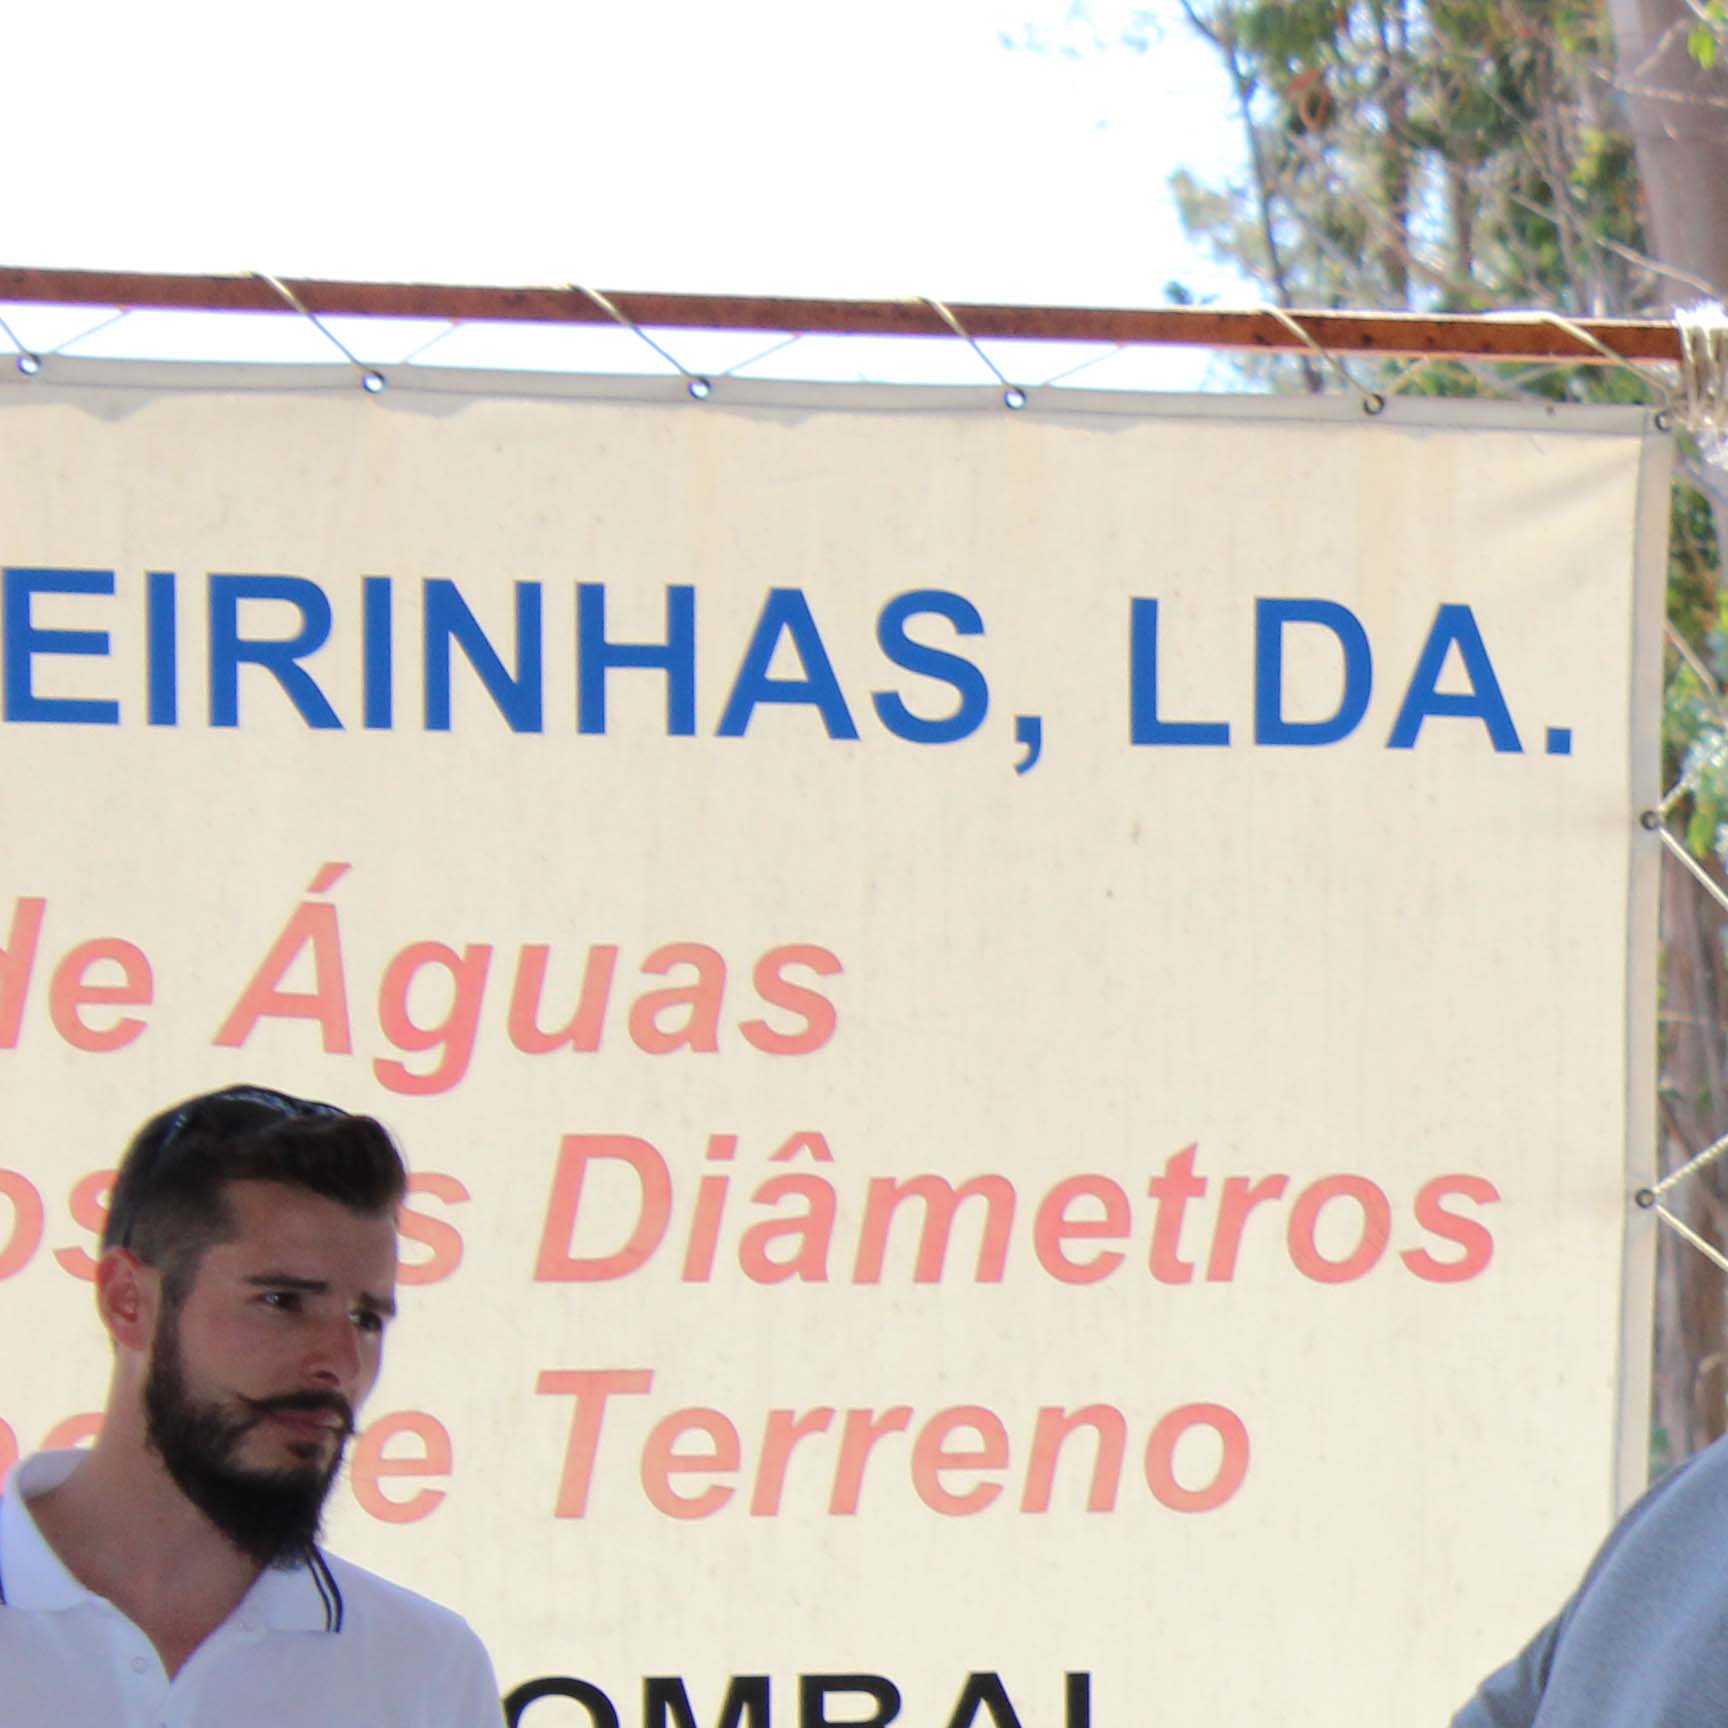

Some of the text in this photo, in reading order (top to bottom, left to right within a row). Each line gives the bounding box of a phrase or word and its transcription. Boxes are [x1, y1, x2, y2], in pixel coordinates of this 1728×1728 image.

[0, 566, 1574, 776] EIRINHAS, LDA.
[211, 862, 844, 1097] Águas
[534, 1132, 1496, 1286] Diâmetros
[536, 1369, 1253, 1522] Terreno
